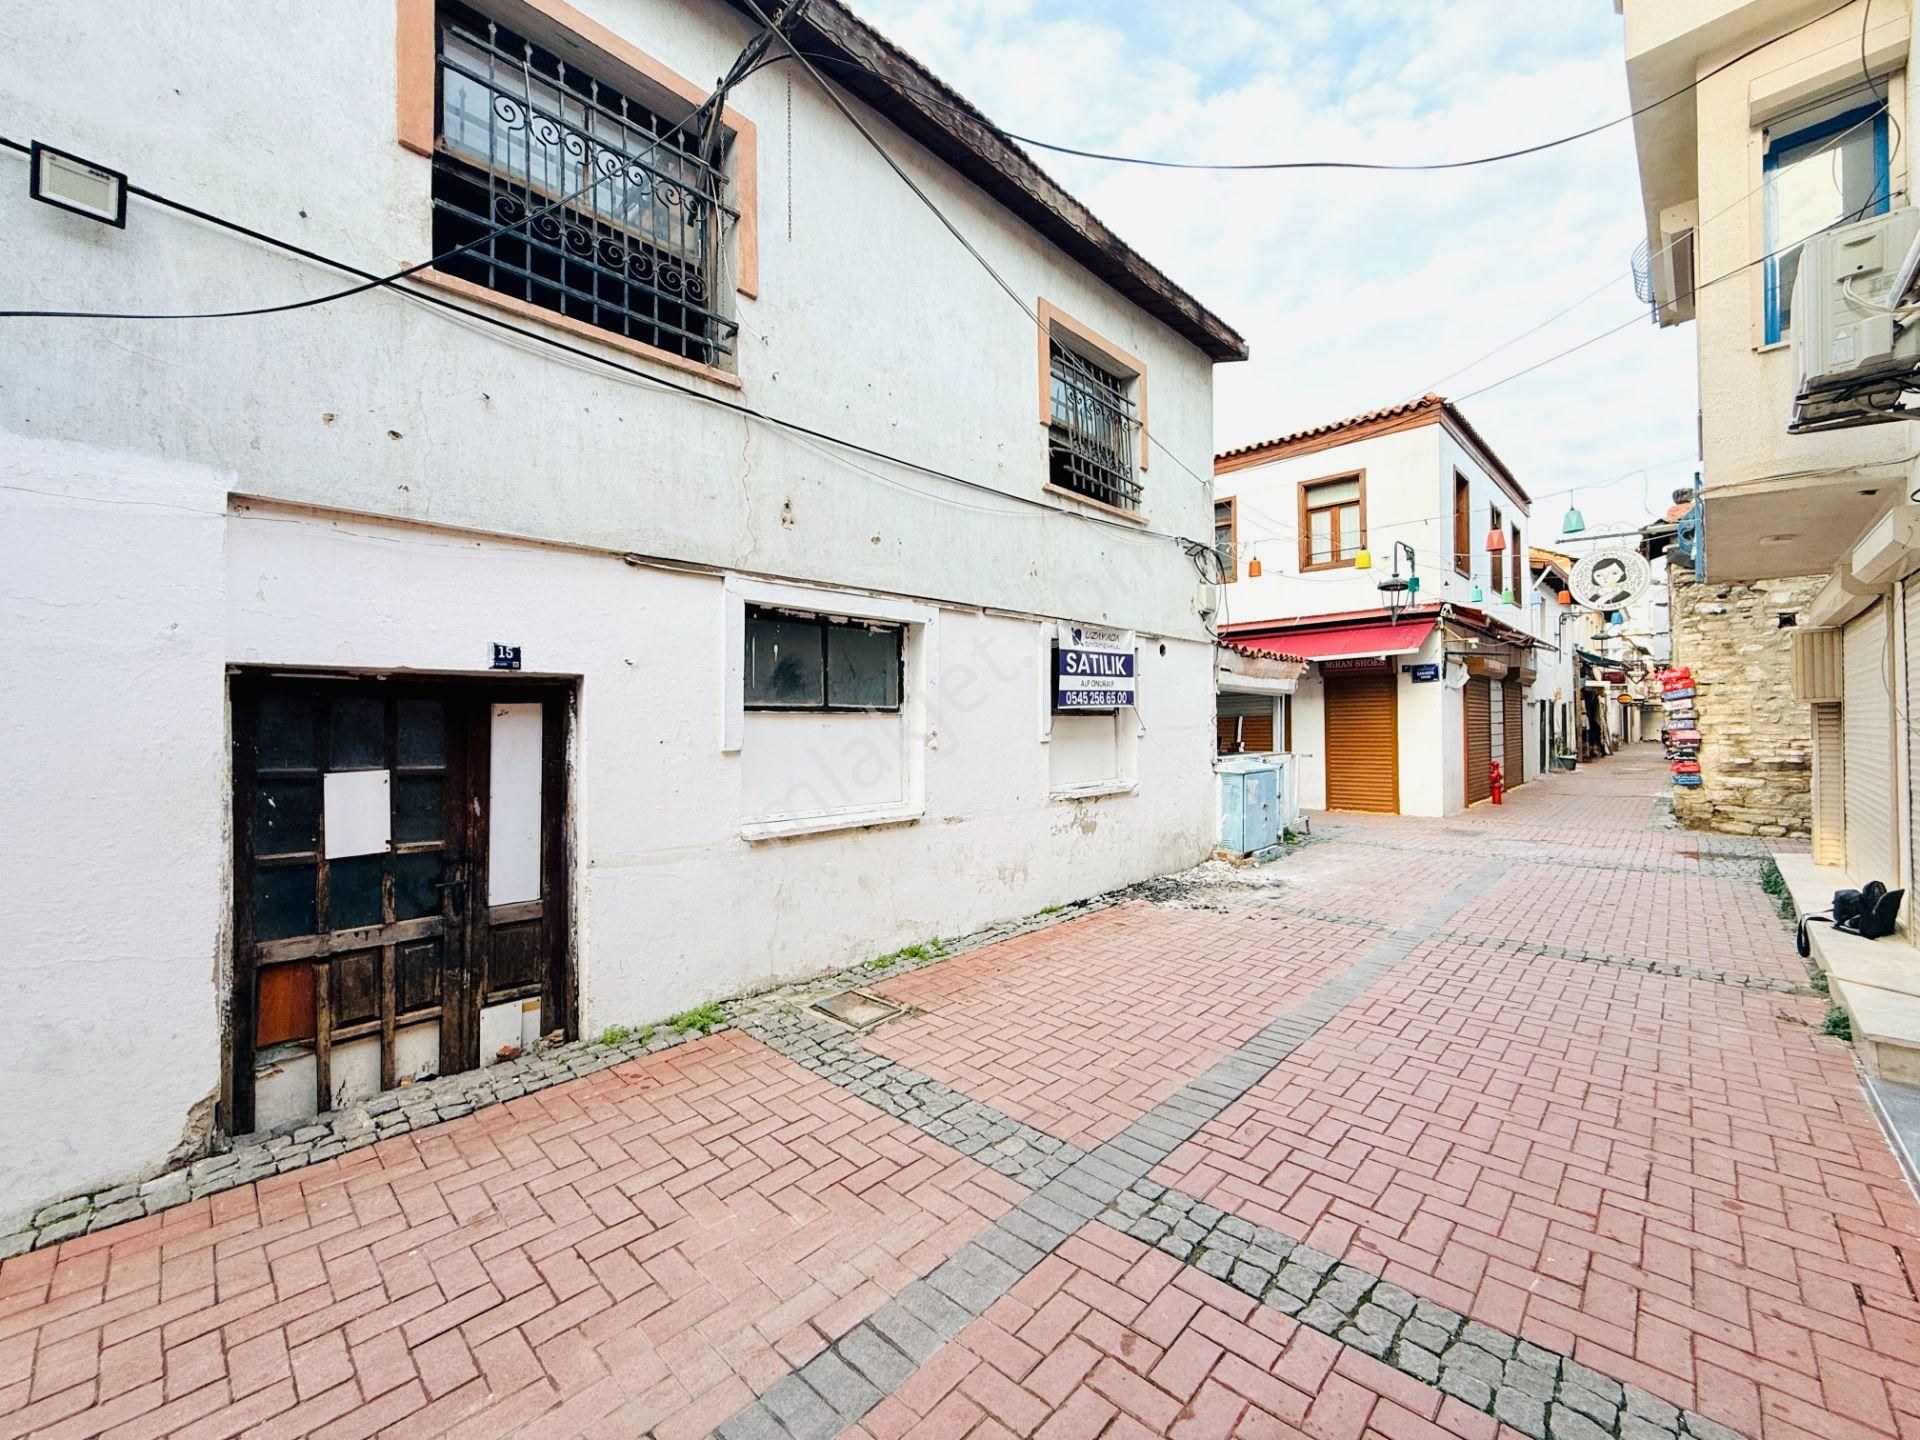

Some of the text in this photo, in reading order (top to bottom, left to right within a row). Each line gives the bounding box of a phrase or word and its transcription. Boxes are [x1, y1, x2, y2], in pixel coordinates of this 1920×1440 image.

[498, 646, 513, 658] 15
[1066, 652, 1127, 675] SATILIK
[1066, 691, 1127, 704] 0545 256 65 00
